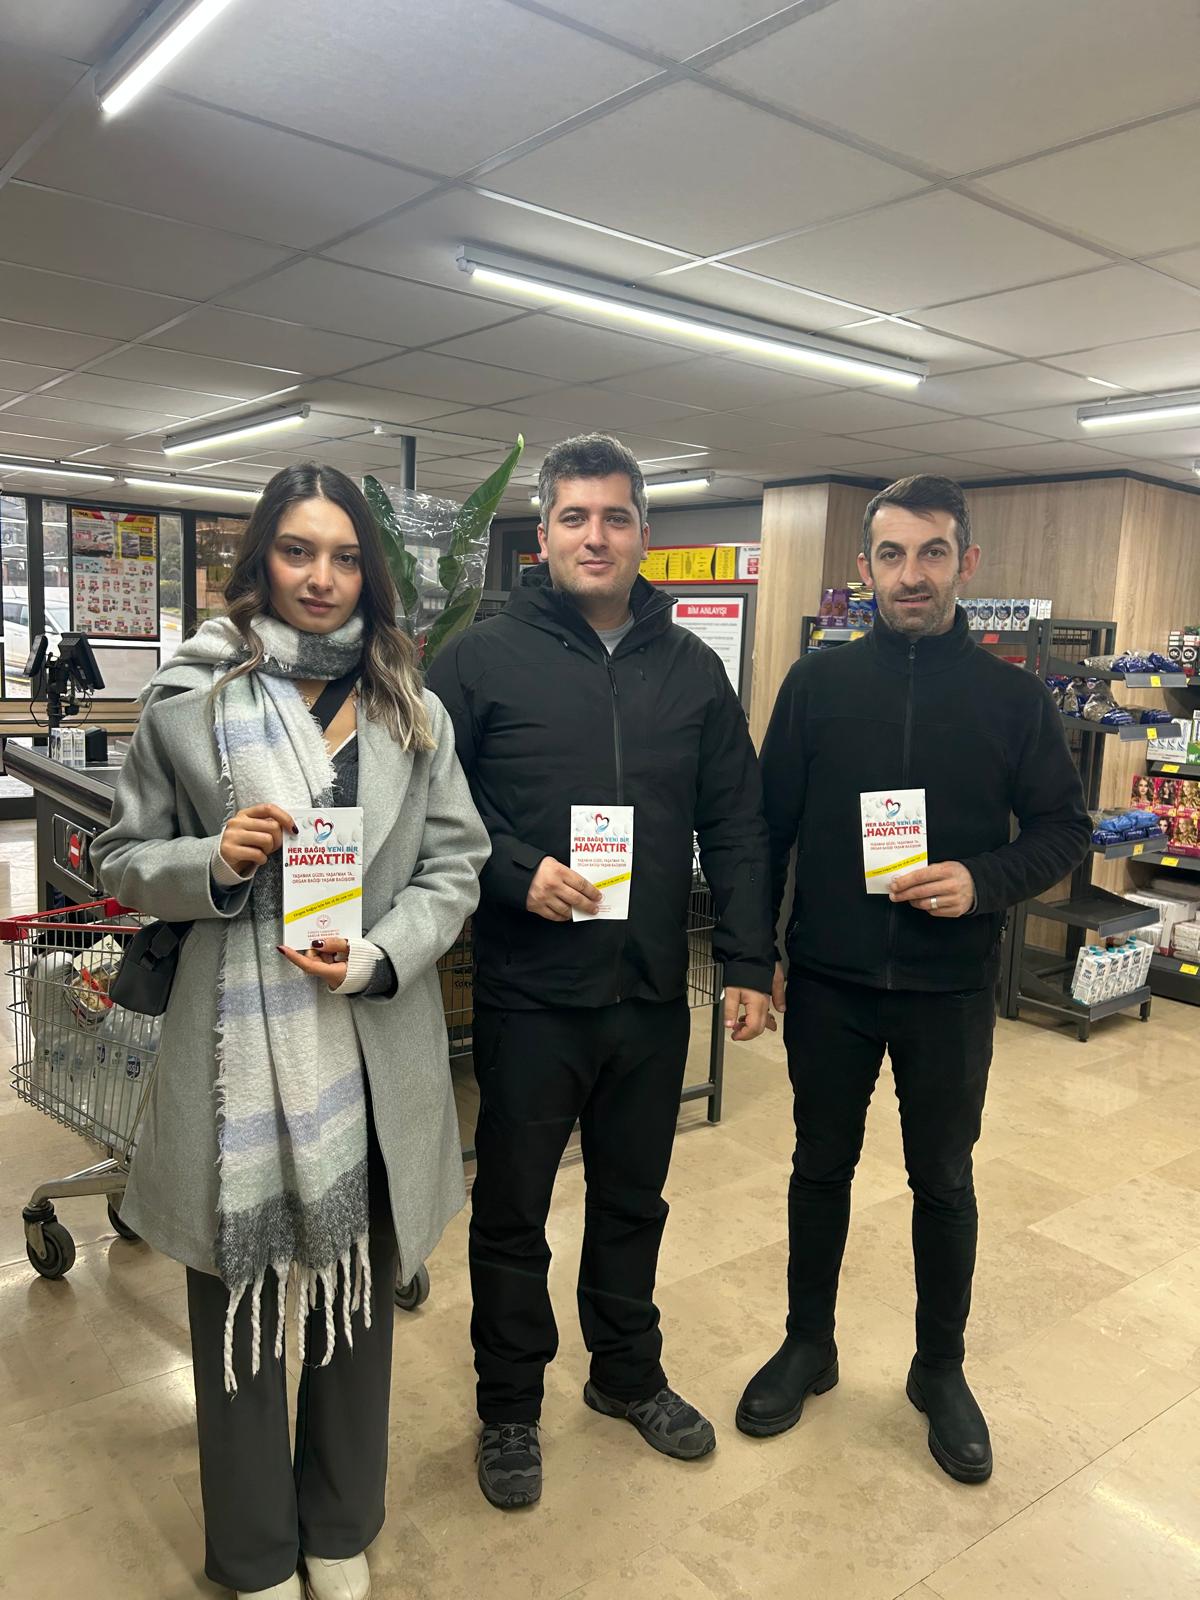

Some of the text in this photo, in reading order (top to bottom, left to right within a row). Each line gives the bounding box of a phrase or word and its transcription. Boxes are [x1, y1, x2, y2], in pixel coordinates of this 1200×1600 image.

[688, 605, 727, 616] BİM ANLAYIŞI
[867, 826, 920, 836] HAYATTIR
[304, 846, 325, 854] BAĞIŞ
[575, 843, 627, 852] HAYATTIR
[289, 854, 355, 865] HAYATTIR
